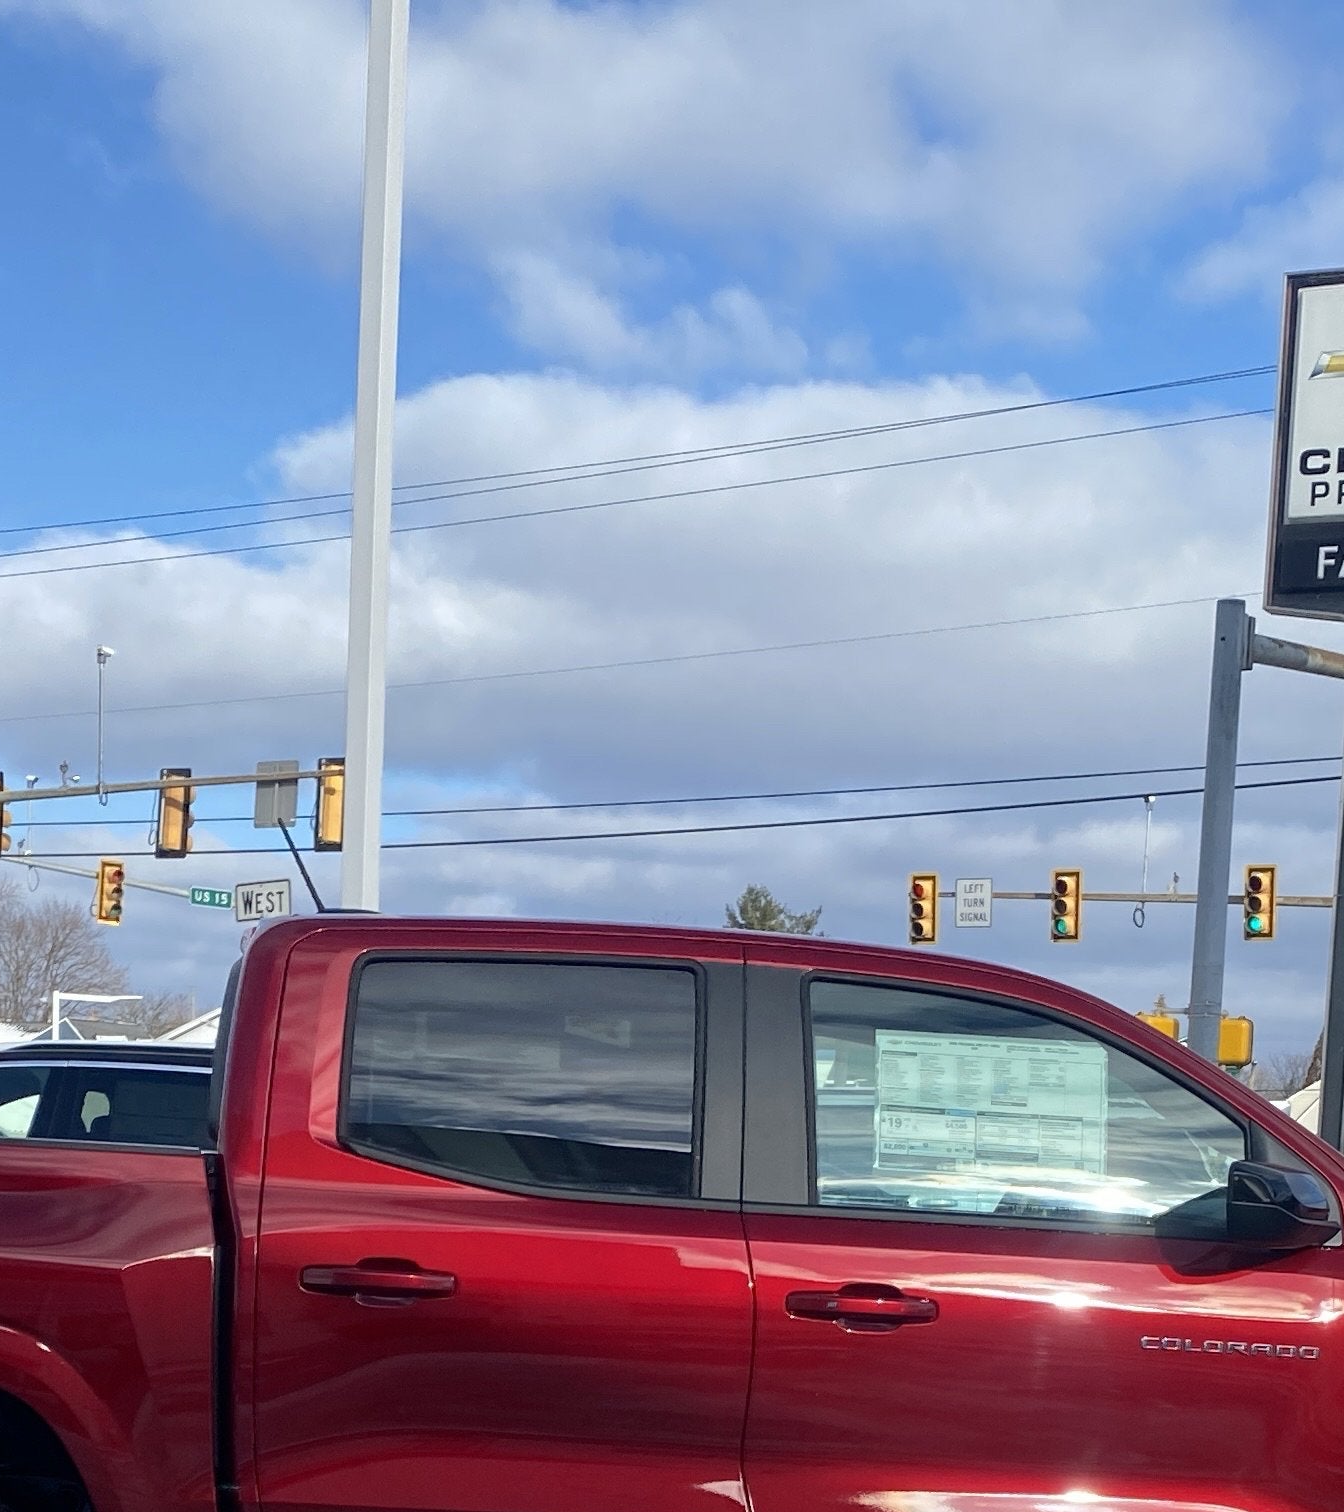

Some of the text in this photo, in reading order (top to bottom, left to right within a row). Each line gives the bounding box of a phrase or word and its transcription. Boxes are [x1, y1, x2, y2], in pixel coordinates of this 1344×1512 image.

[964, 884, 984, 893] LEFT
[194, 890, 228, 905] US 15
[242, 890, 284, 915] WEST
[963, 898, 985, 907] TURN
[959, 912, 988, 921] SIGNAL
[887, 1117, 902, 1128] 19
[1140, 1335, 1320, 1360] COLORADO
